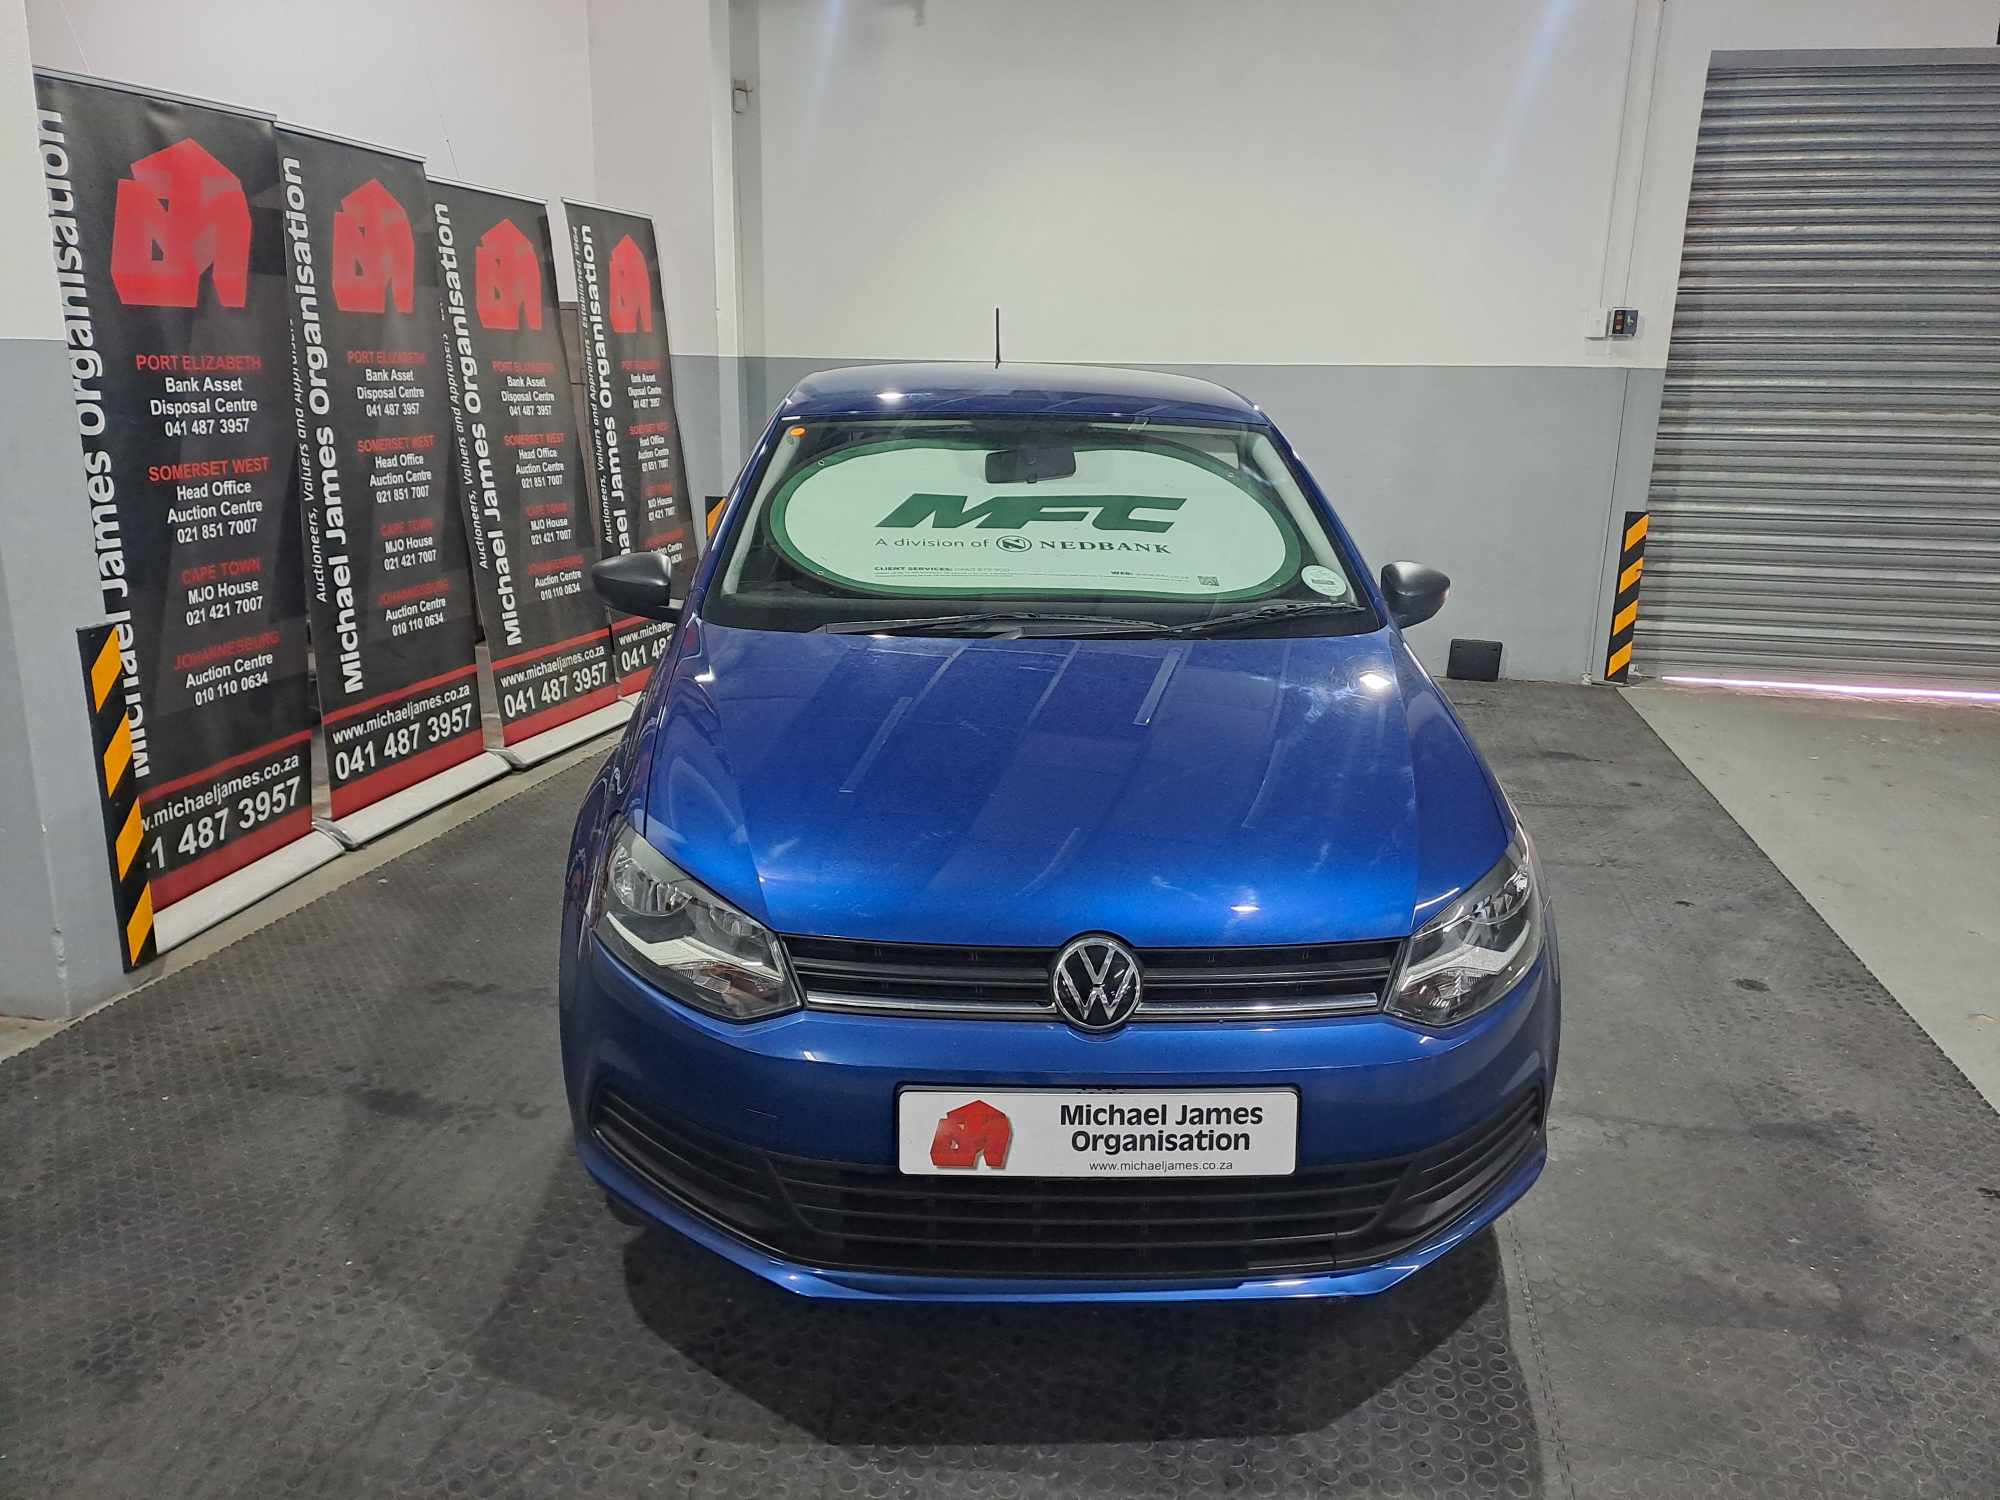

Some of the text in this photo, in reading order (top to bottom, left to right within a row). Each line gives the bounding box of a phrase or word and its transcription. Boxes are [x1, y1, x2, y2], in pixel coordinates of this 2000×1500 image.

[283, 157, 330, 415] Organisation
[582, 225, 612, 409] Organisation
[136, 355, 262, 371] PORT ELIZABETH
[365, 369, 414, 382] Bank Asset
[165, 376, 243, 393] Bank Asset
[357, 385, 424, 401] Disposal Centre
[507, 376, 524, 388] Bank
[150, 398, 258, 417] Disposal Centre
[366, 402, 420, 417] 041 487 3957
[501, 391, 555, 403] Disposal Centre
[165, 417, 250, 437] 041 487 3957
[434, 202, 522, 647] Michael James Organisation
[452, 407, 464, 433] and
[148, 456, 270, 482] SOMERSET WEST
[375, 453, 424, 469] Head Office
[456, 436, 473, 486] Valuers
[604, 416, 625, 502] James
[299, 443, 316, 502] Valuers
[316, 426, 347, 545] James
[369, 469, 432, 488] Auction Centre
[176, 480, 252, 501] Head Office
[376, 485, 429, 503] 021 851 7007
[84, 450, 128, 598] James
[166, 500, 263, 524] Auction Centre
[875, 493, 1187, 533] MFC
[177, 518, 258, 544] 021 851 7007
[468, 489, 488, 569] Auctioneers,
[308, 507, 327, 602] Auctioneers,
[385, 535, 433, 554] MJO House
[875, 537, 1171, 554] A division of NEDBANK
[384, 549, 437, 571] 021 421 7007
[560, 569, 582, 581] Centre
[188, 579, 259, 605] MJO House
[186, 596, 263, 626] 021 421 7007
[385, 596, 446, 622] Auction Centre
[328, 555, 364, 694] Michael
[392, 613, 444, 637] 010 110 0634
[185, 652, 274, 689] Auction Centre
[500, 644, 605, 688] www.michaeljames.co.za
[622, 645, 647, 671] 041
[195, 671, 269, 706] 010 110 0634
[504, 662, 607, 718] 041 487 3957
[332, 684, 470, 745] www.michaeljames.co.za
[335, 703, 473, 781] 041 487 3957
[177, 808, 229, 855] 487
[238, 776, 300, 829] 3957
[1060, 1103, 1264, 1126] Michael James
[1071, 1129, 1251, 1155] Organisation
[1089, 1160, 1234, 1173] www.michaeljames.co.za
